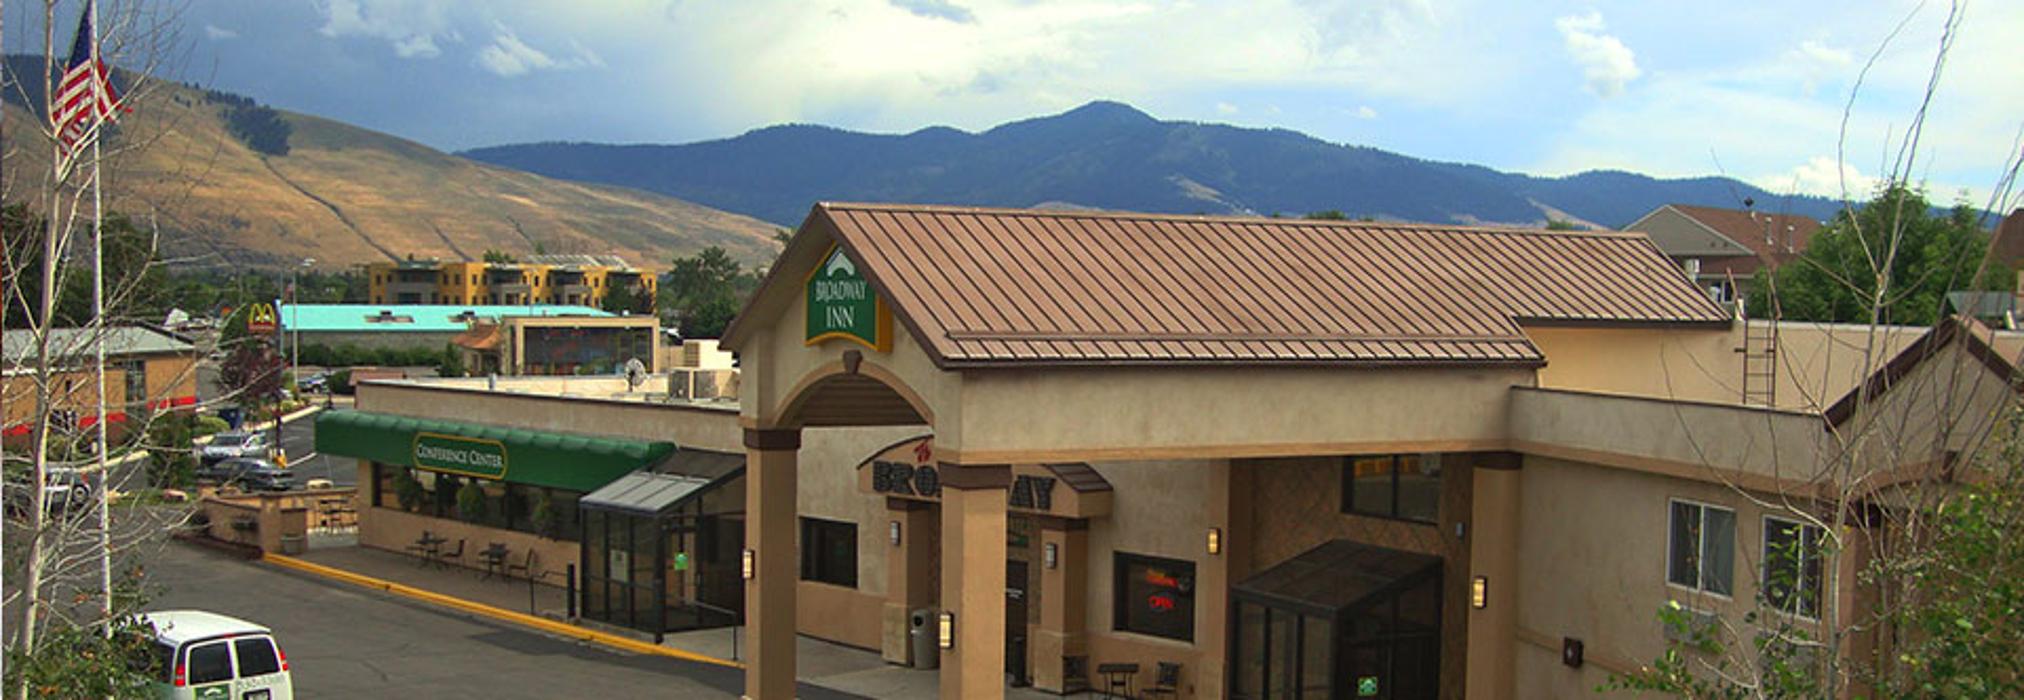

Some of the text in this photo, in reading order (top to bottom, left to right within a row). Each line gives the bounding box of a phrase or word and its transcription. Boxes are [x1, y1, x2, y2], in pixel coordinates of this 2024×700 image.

[816, 281, 867, 302] BROADWAY
[825, 305, 855, 328] INN
[417, 444, 503, 467] CONFERENCE CENTER
[873, 461, 1057, 511] BROAY
